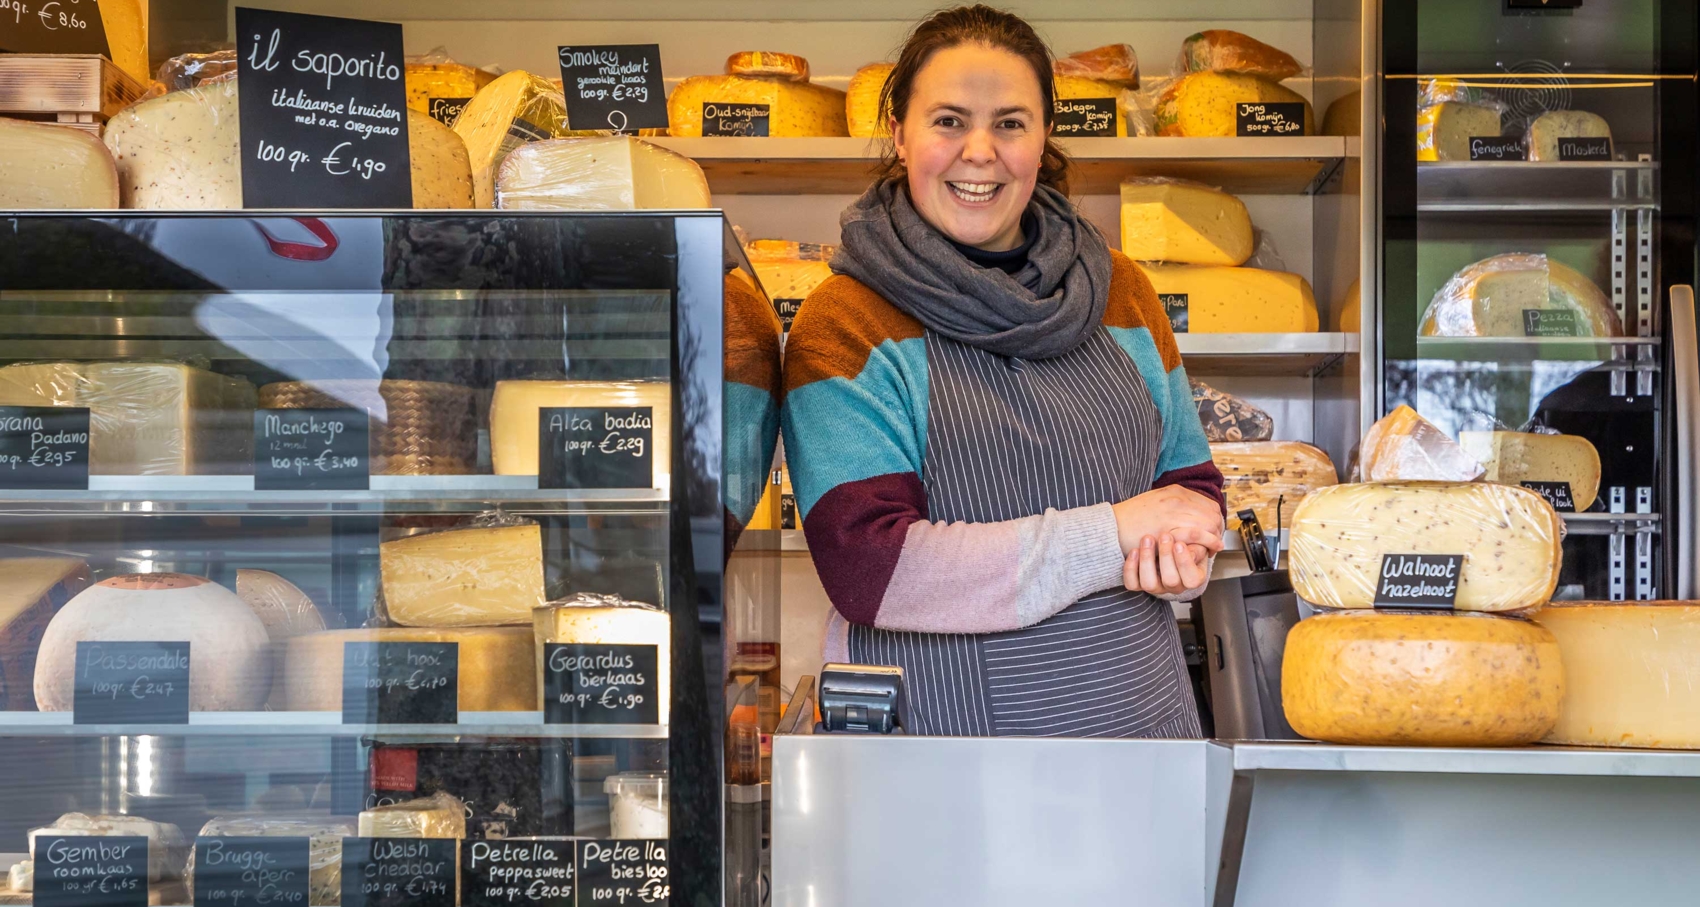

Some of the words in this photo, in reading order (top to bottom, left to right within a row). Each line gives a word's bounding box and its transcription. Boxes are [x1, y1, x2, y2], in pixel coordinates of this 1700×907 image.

[248, 28, 280, 71] il
[292, 50, 400, 90] saporito
[560, 47, 618, 68] Smokey
[621, 75, 646, 84] kaas
[271, 88, 344, 114] italiaanse
[348, 97, 401, 122] kruiden
[1054, 101, 1096, 115] Belegen
[1240, 104, 1266, 117] Jong
[295, 113, 316, 125] met
[319, 117, 340, 128] o.a.
[257, 140, 285, 162] 100
[265, 414, 344, 445] Manchego
[549, 413, 593, 432] Alta
[604, 412, 652, 431] badia
[31, 429, 88, 450] Padano
[1555, 485, 1567, 497] ui
[1383, 556, 1456, 578] Walnoot
[1381, 578, 1456, 598] hazelnoot
[84, 645, 189, 679] Passendale
[549, 646, 634, 673] Gerardus
[580, 670, 645, 688] bierkaas
[47, 838, 131, 864] Gember
[373, 840, 429, 860] Welsh
[471, 842, 559, 869] Petrella
[583, 840, 667, 869] Petrella
[53, 863, 133, 878] roomkaas
[489, 862, 575, 884] peppasweet
[611, 862, 668, 879] biesloo
[62, 881, 80, 891] 100
[207, 889, 227, 900] 100
[485, 886, 504, 898] 100
[592, 888, 613, 900] 100
